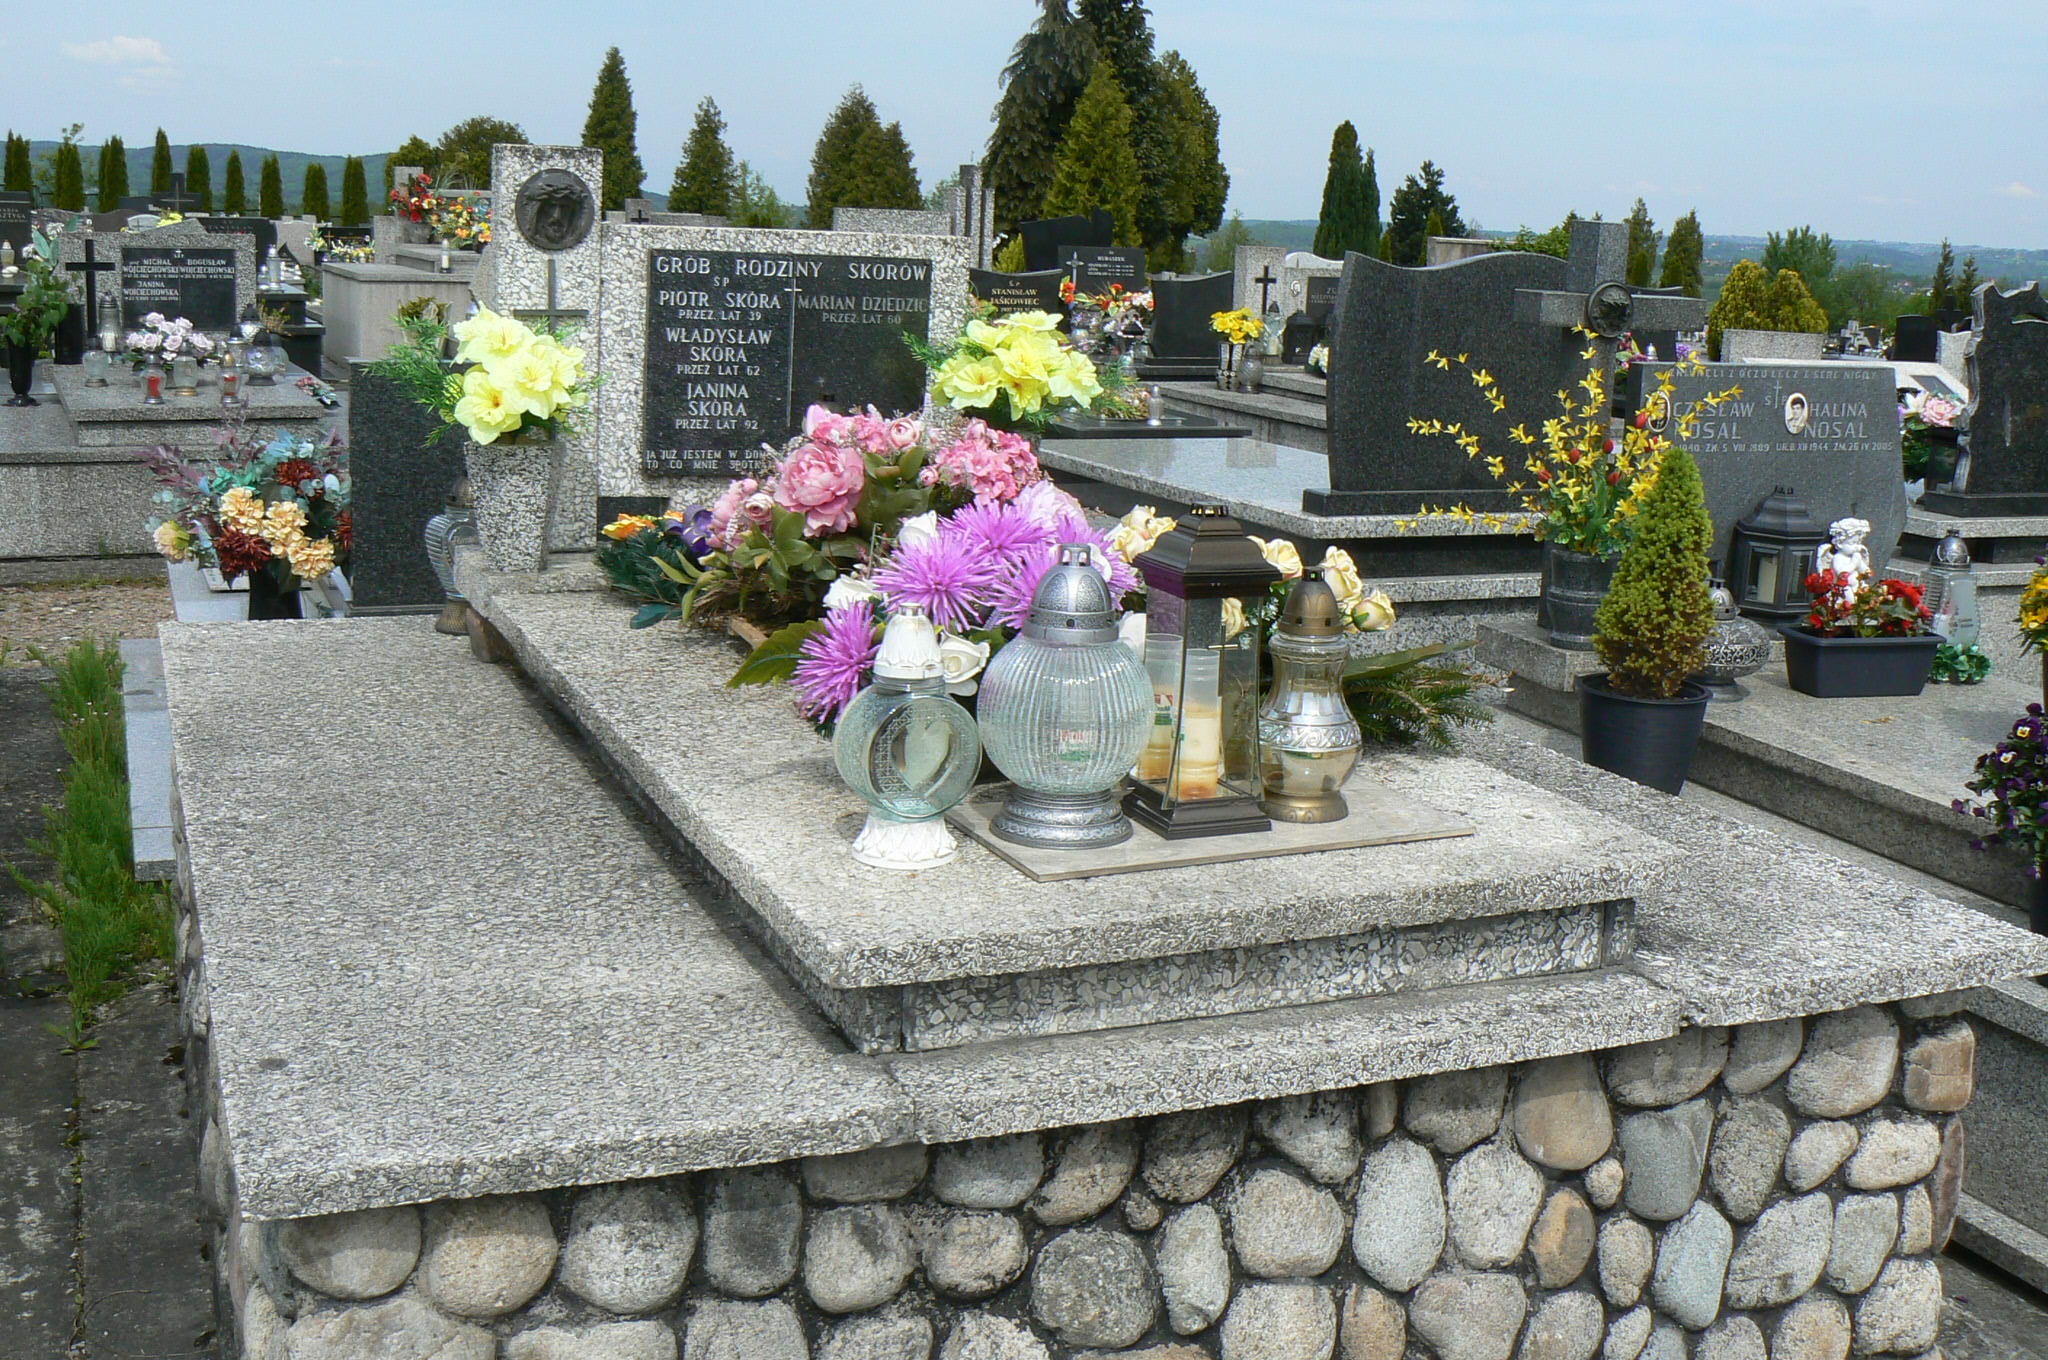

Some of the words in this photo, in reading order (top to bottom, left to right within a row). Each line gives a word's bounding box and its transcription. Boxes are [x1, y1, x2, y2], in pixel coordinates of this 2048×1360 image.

[656, 255, 711, 274] GRÓB
[735, 259, 823, 278] RODZINY
[848, 262, 927, 281] SKORÓW
[659, 290, 710, 307] PIOTR
[725, 291, 781, 309] SKÓRA
[797, 295, 855, 311] MARIAN
[862, 296, 928, 313] DZIEDZIC
[721, 310, 741, 320] LAT
[749, 311, 762, 321] 39
[862, 314, 882, 324] LAT
[888, 314, 901, 324] 60
[665, 327, 773, 345] WŁADYSŁAW
[690, 345, 748, 362] SKÓRA
[718, 365, 740, 376] LAT
[747, 366, 760, 376] 62
[687, 383, 750, 400] JANINA
[688, 400, 748, 417] SKÓRA
[1810, 403, 1868, 418] HALINA
[716, 420, 738, 430] LAT
[744, 420, 758, 430] 92
[1804, 422, 1868, 438] NOSAL
[646, 450, 657, 460] JA
[684, 450, 722, 460] JESTEM
[728, 450, 739, 459] W
[646, 460, 659, 469] TO
[670, 460, 683, 469] CO
[693, 460, 719, 470] MNIE
